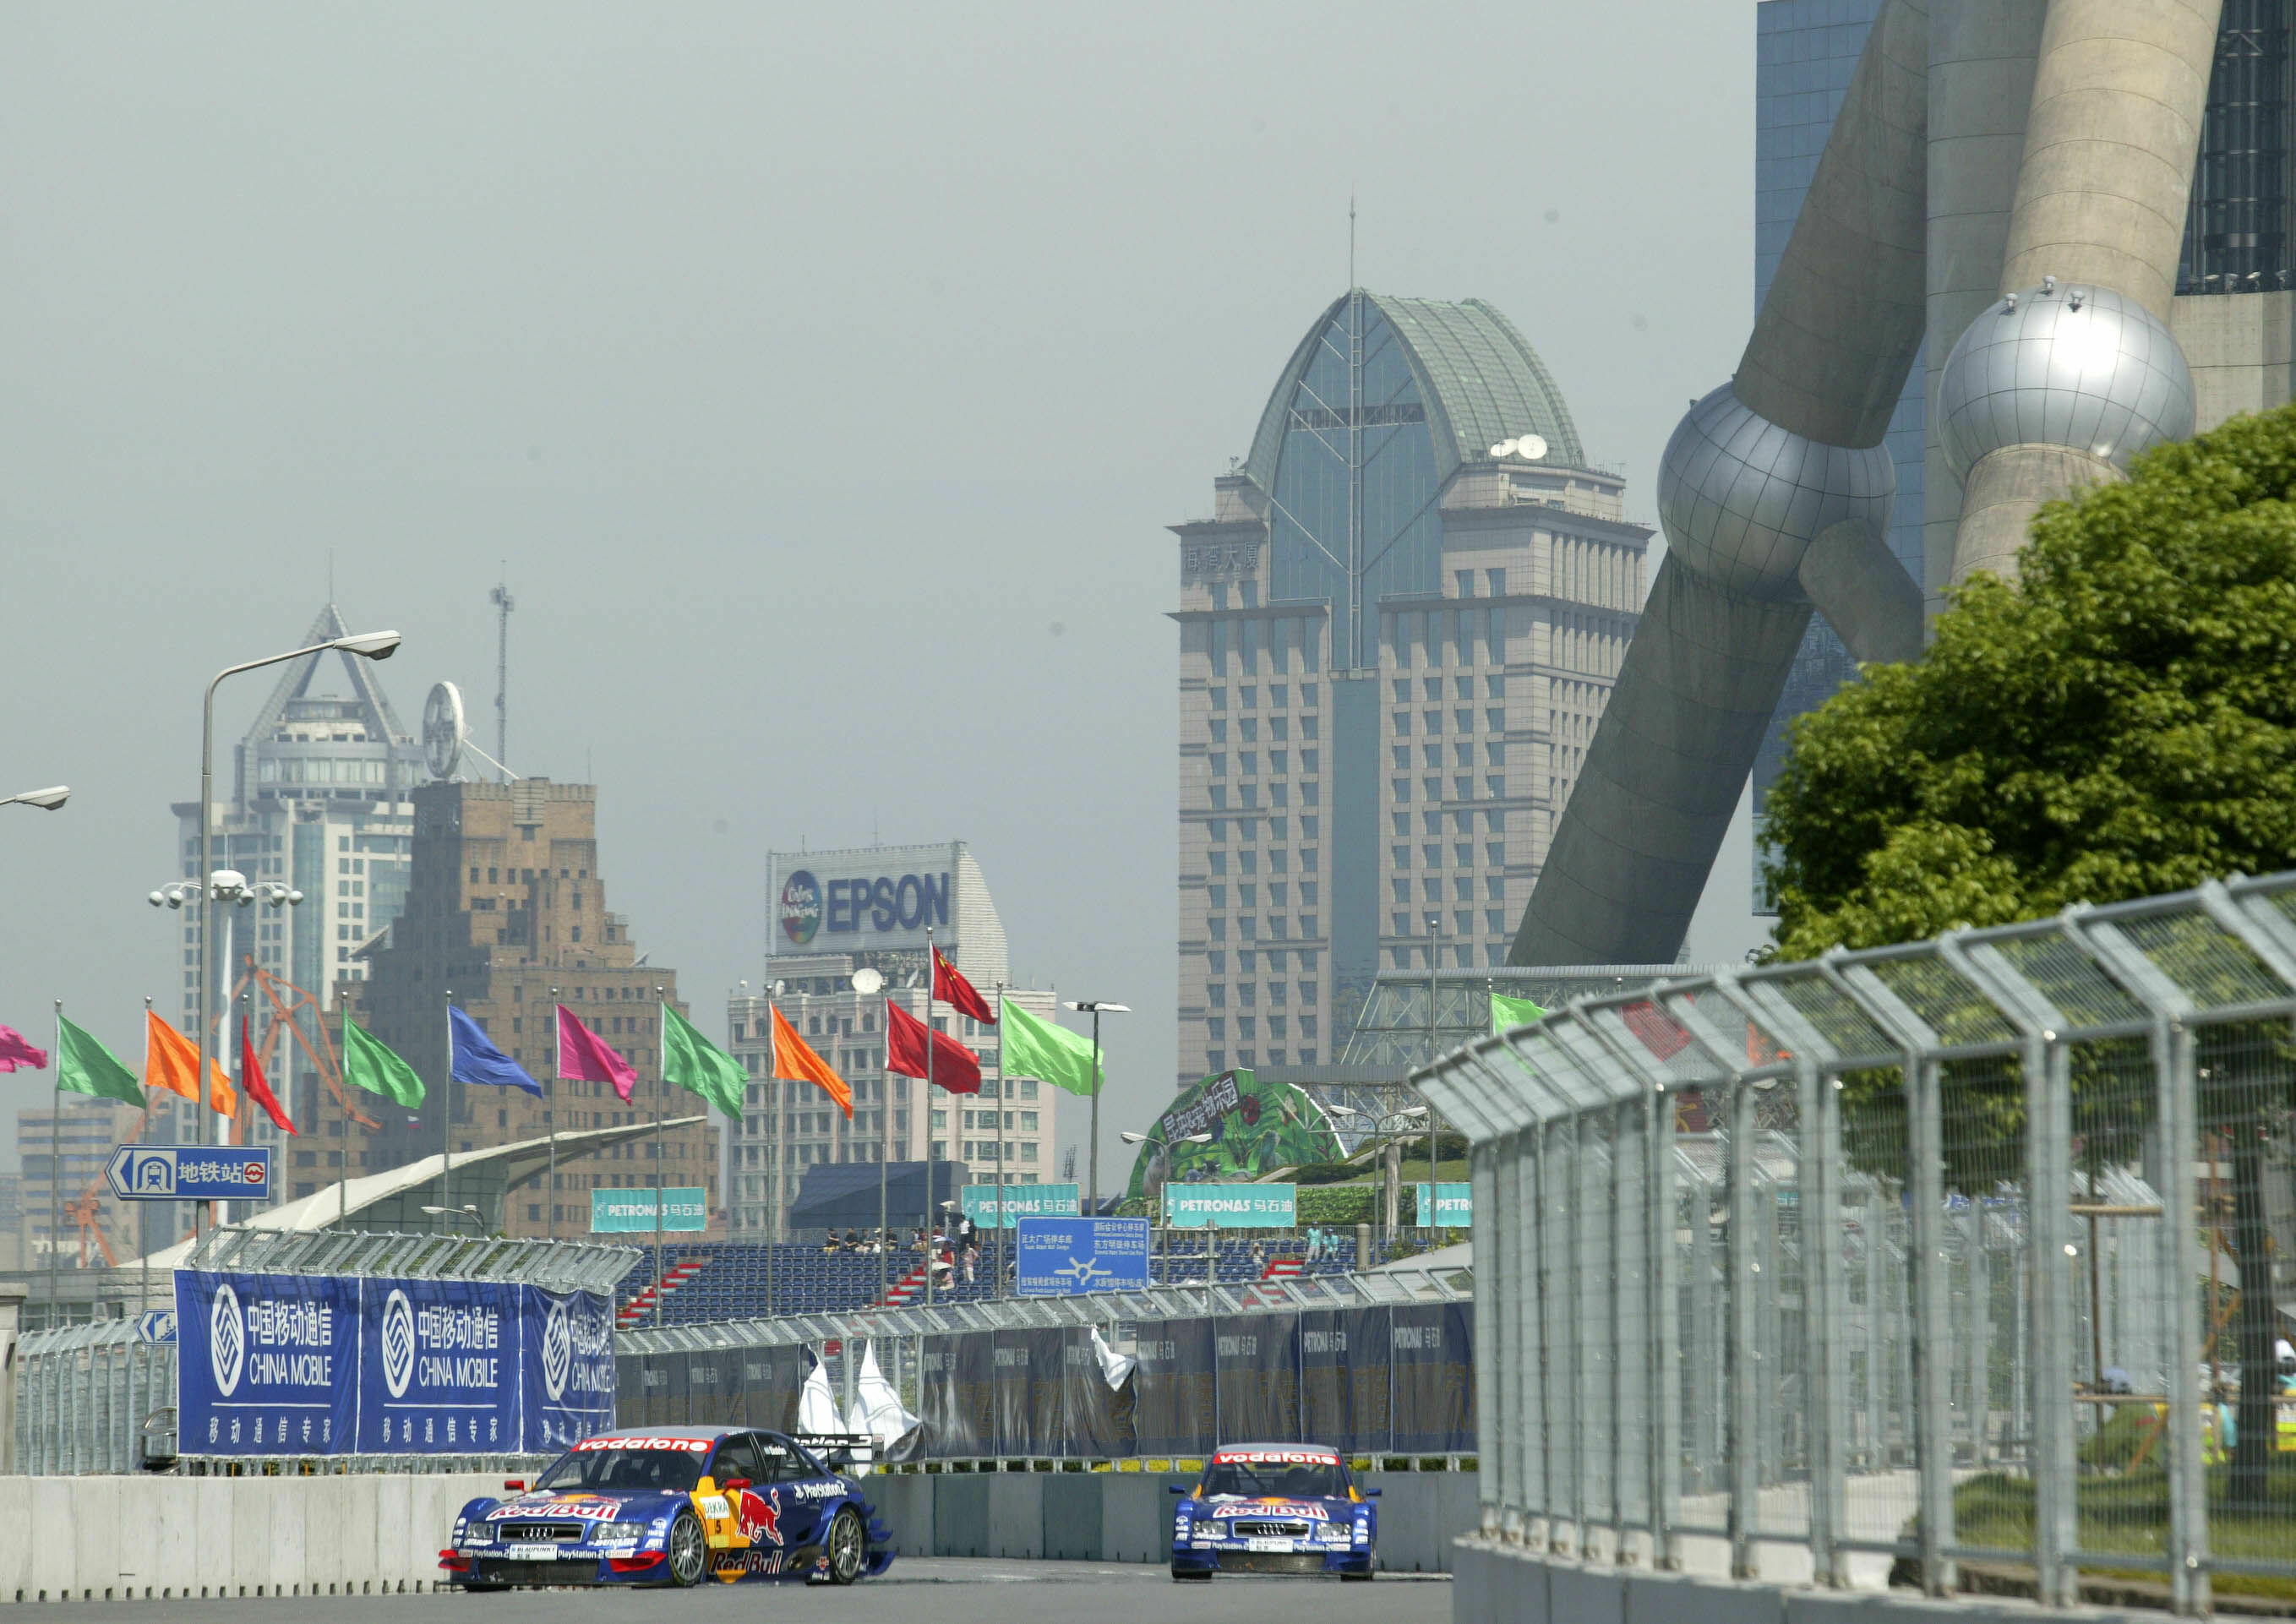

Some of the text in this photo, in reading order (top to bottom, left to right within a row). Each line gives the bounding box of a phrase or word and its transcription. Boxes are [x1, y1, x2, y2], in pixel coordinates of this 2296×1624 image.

[827, 872, 949, 932] EPSON
[178, 1161, 243, 1183] 地铁站
[671, 1203, 704, 1217] 马石油
[980, 1199, 1077, 1213] PETRONAS 马石油
[1181, 1199, 1293, 1213] PETRONAS 马石油
[1437, 1198, 1472, 1211] PETR
[248, 1297, 332, 1347] 中国移动通信
[418, 1302, 499, 1350] 中国移动通信
[249, 1353, 332, 1387] CHINA MOBILE
[419, 1355, 499, 1388] CHINA MOBILE
[210, 1415, 331, 1444] 移动通信专家
[383, 1416, 498, 1443] 移动通信专家
[579, 1437, 708, 1452] vodafone
[1219, 1452, 1337, 1464] vodafone
[486, 1503, 621, 1522] Red Bull
[703, 1501, 728, 1514] DEKRA
[1213, 1505, 1328, 1520] Red Bull
[716, 1520, 722, 1534] 5
[710, 1550, 783, 1575] Red Bull
